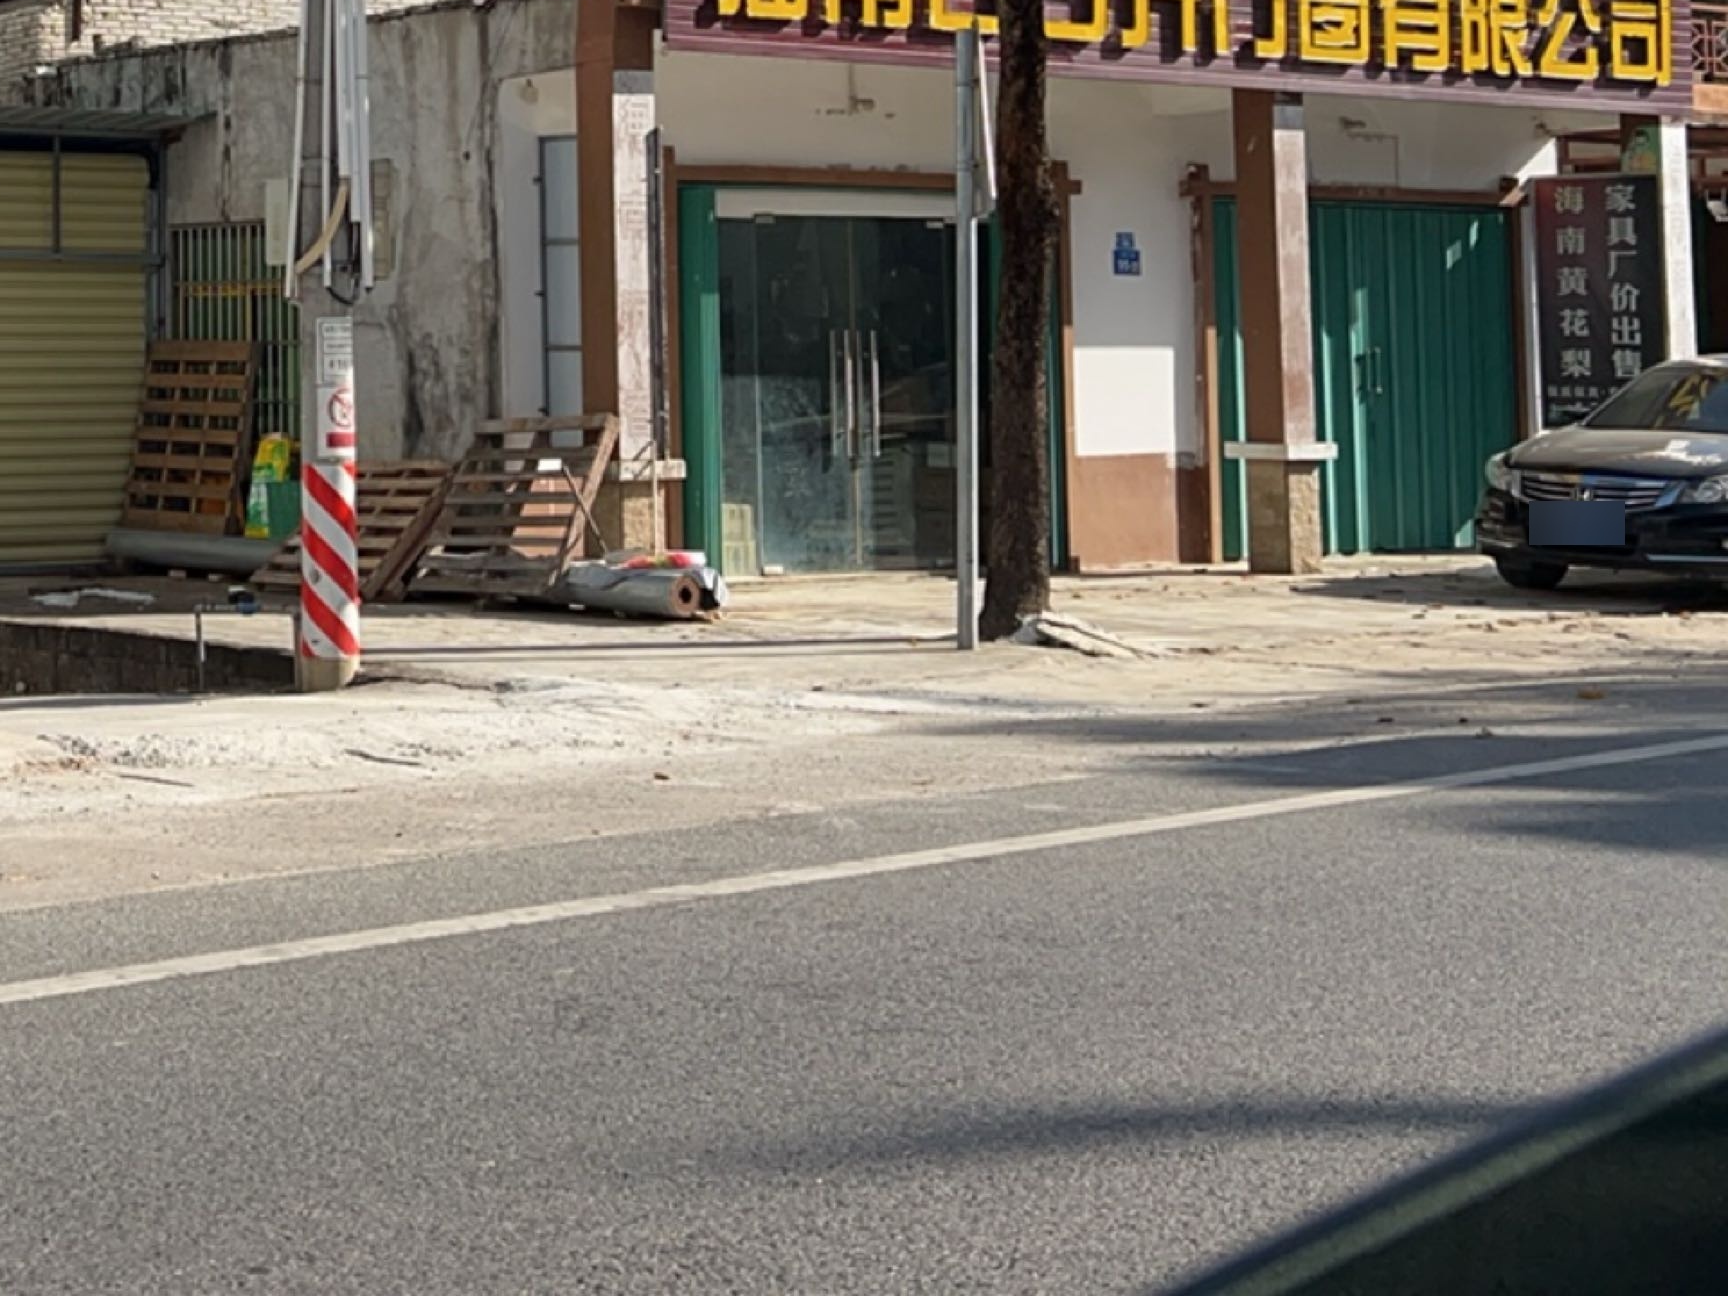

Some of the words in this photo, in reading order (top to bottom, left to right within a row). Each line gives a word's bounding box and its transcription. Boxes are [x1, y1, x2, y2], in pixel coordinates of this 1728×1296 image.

[1554, 185, 1592, 378] 海南黄花梨
[1605, 184, 1642, 378] 家具厂价出售
